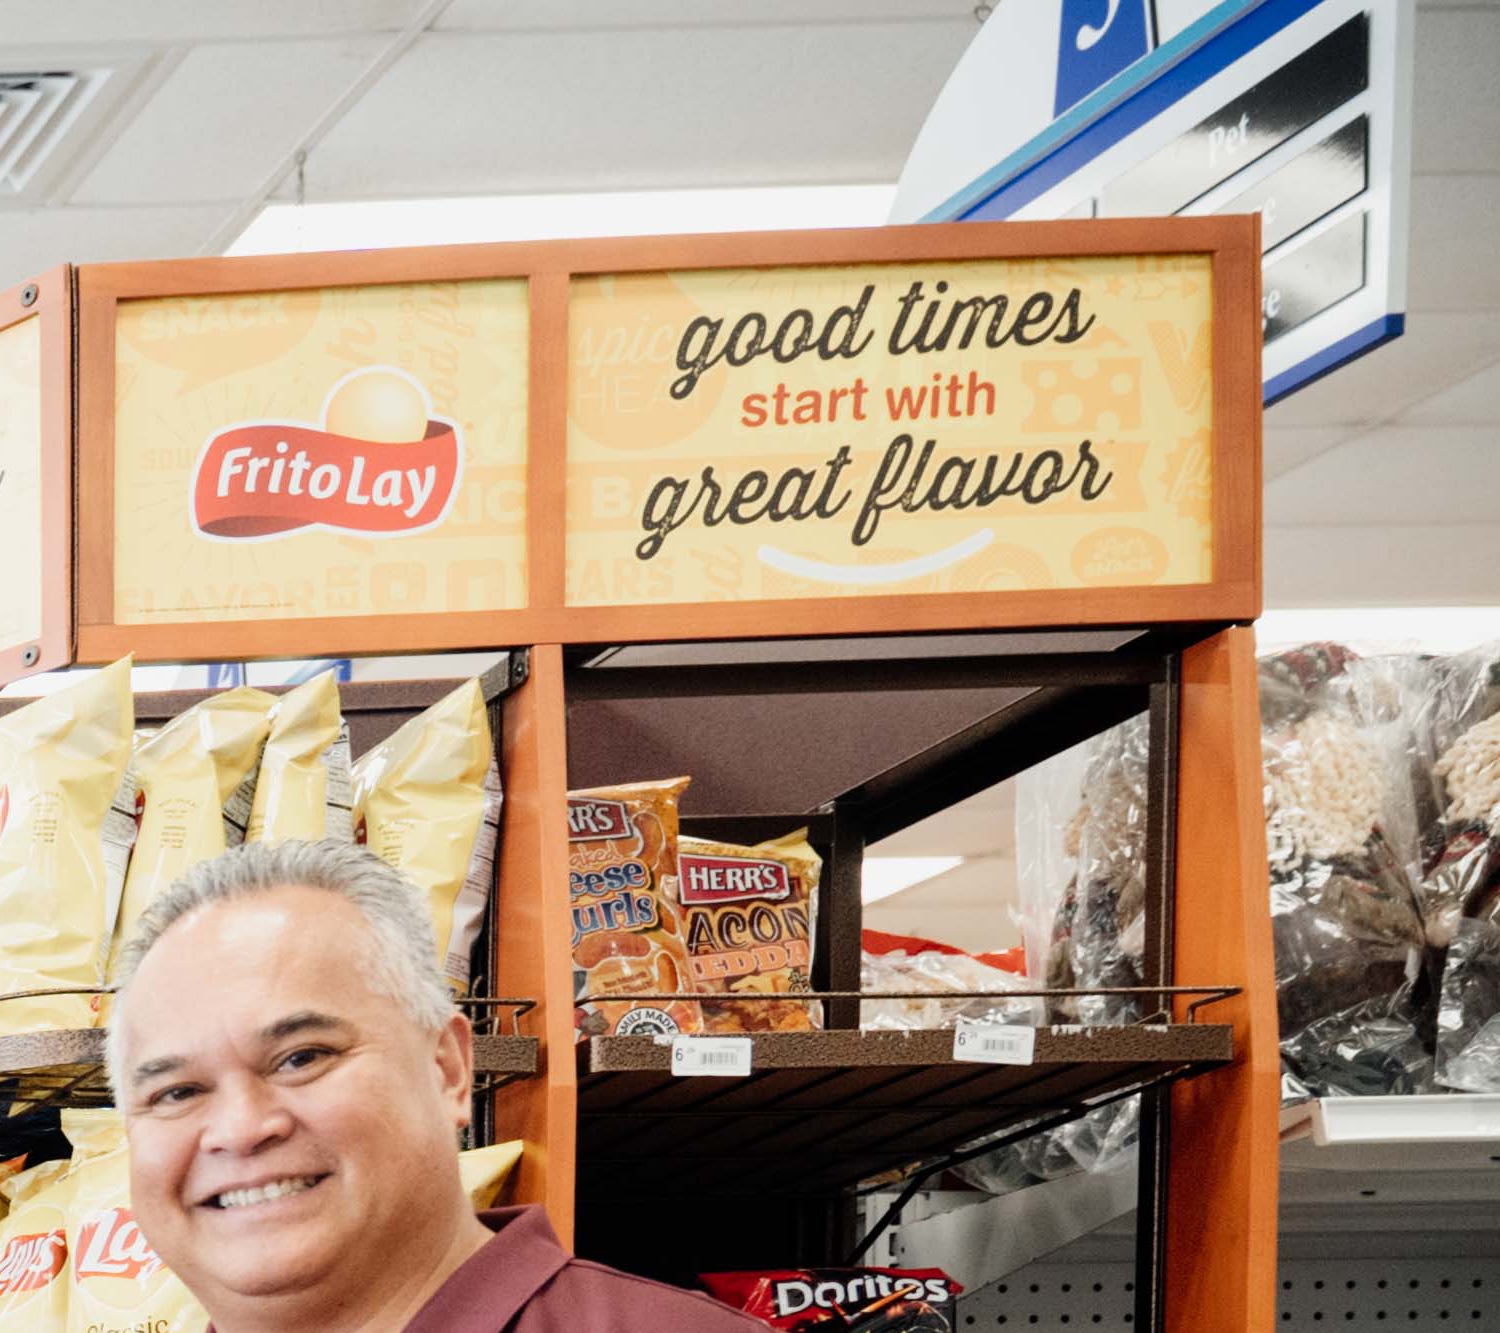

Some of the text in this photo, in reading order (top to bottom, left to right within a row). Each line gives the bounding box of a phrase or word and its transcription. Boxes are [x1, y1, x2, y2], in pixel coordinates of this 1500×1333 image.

[1207, 113, 1250, 168] Pet
[670, 281, 1096, 400] good times
[741, 372, 996, 427] start with
[636, 447, 853, 561] great
[851, 433, 1113, 547] flavor
[569, 861, 645, 899] eese
[570, 841, 624, 867] aked
[689, 863, 778, 892] HERR'S
[571, 892, 655, 945] urls
[686, 902, 810, 954] ACON
[776, 1274, 949, 1317] Doritos
